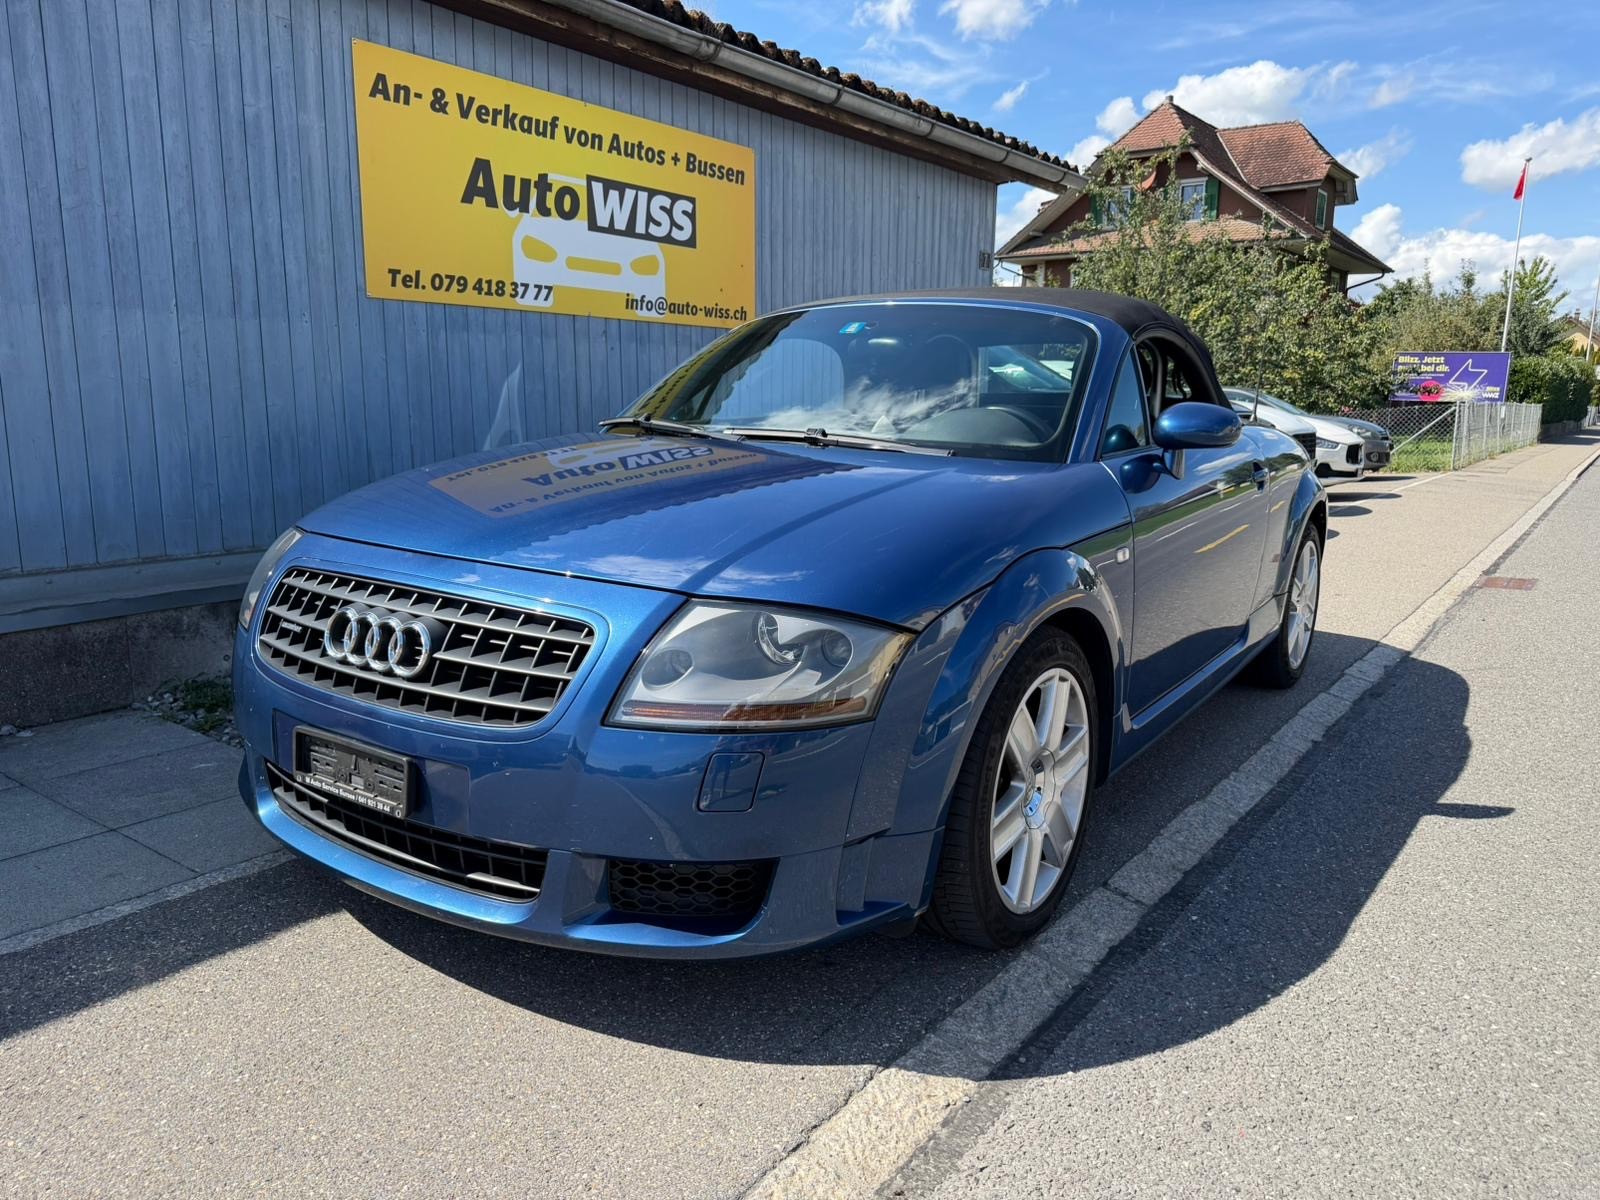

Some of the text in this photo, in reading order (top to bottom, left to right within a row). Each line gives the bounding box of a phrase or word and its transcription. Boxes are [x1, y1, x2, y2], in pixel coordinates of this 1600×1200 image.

[368, 72, 745, 185] An- & Verkauf von Autos + Bussen
[460, 157, 694, 242] Auto WISS
[387, 268, 554, 302] Tel. 079 418 37 77
[625, 293, 747, 321] info@auto-wiss.ch
[1422, 356, 1445, 364] Jetzt
